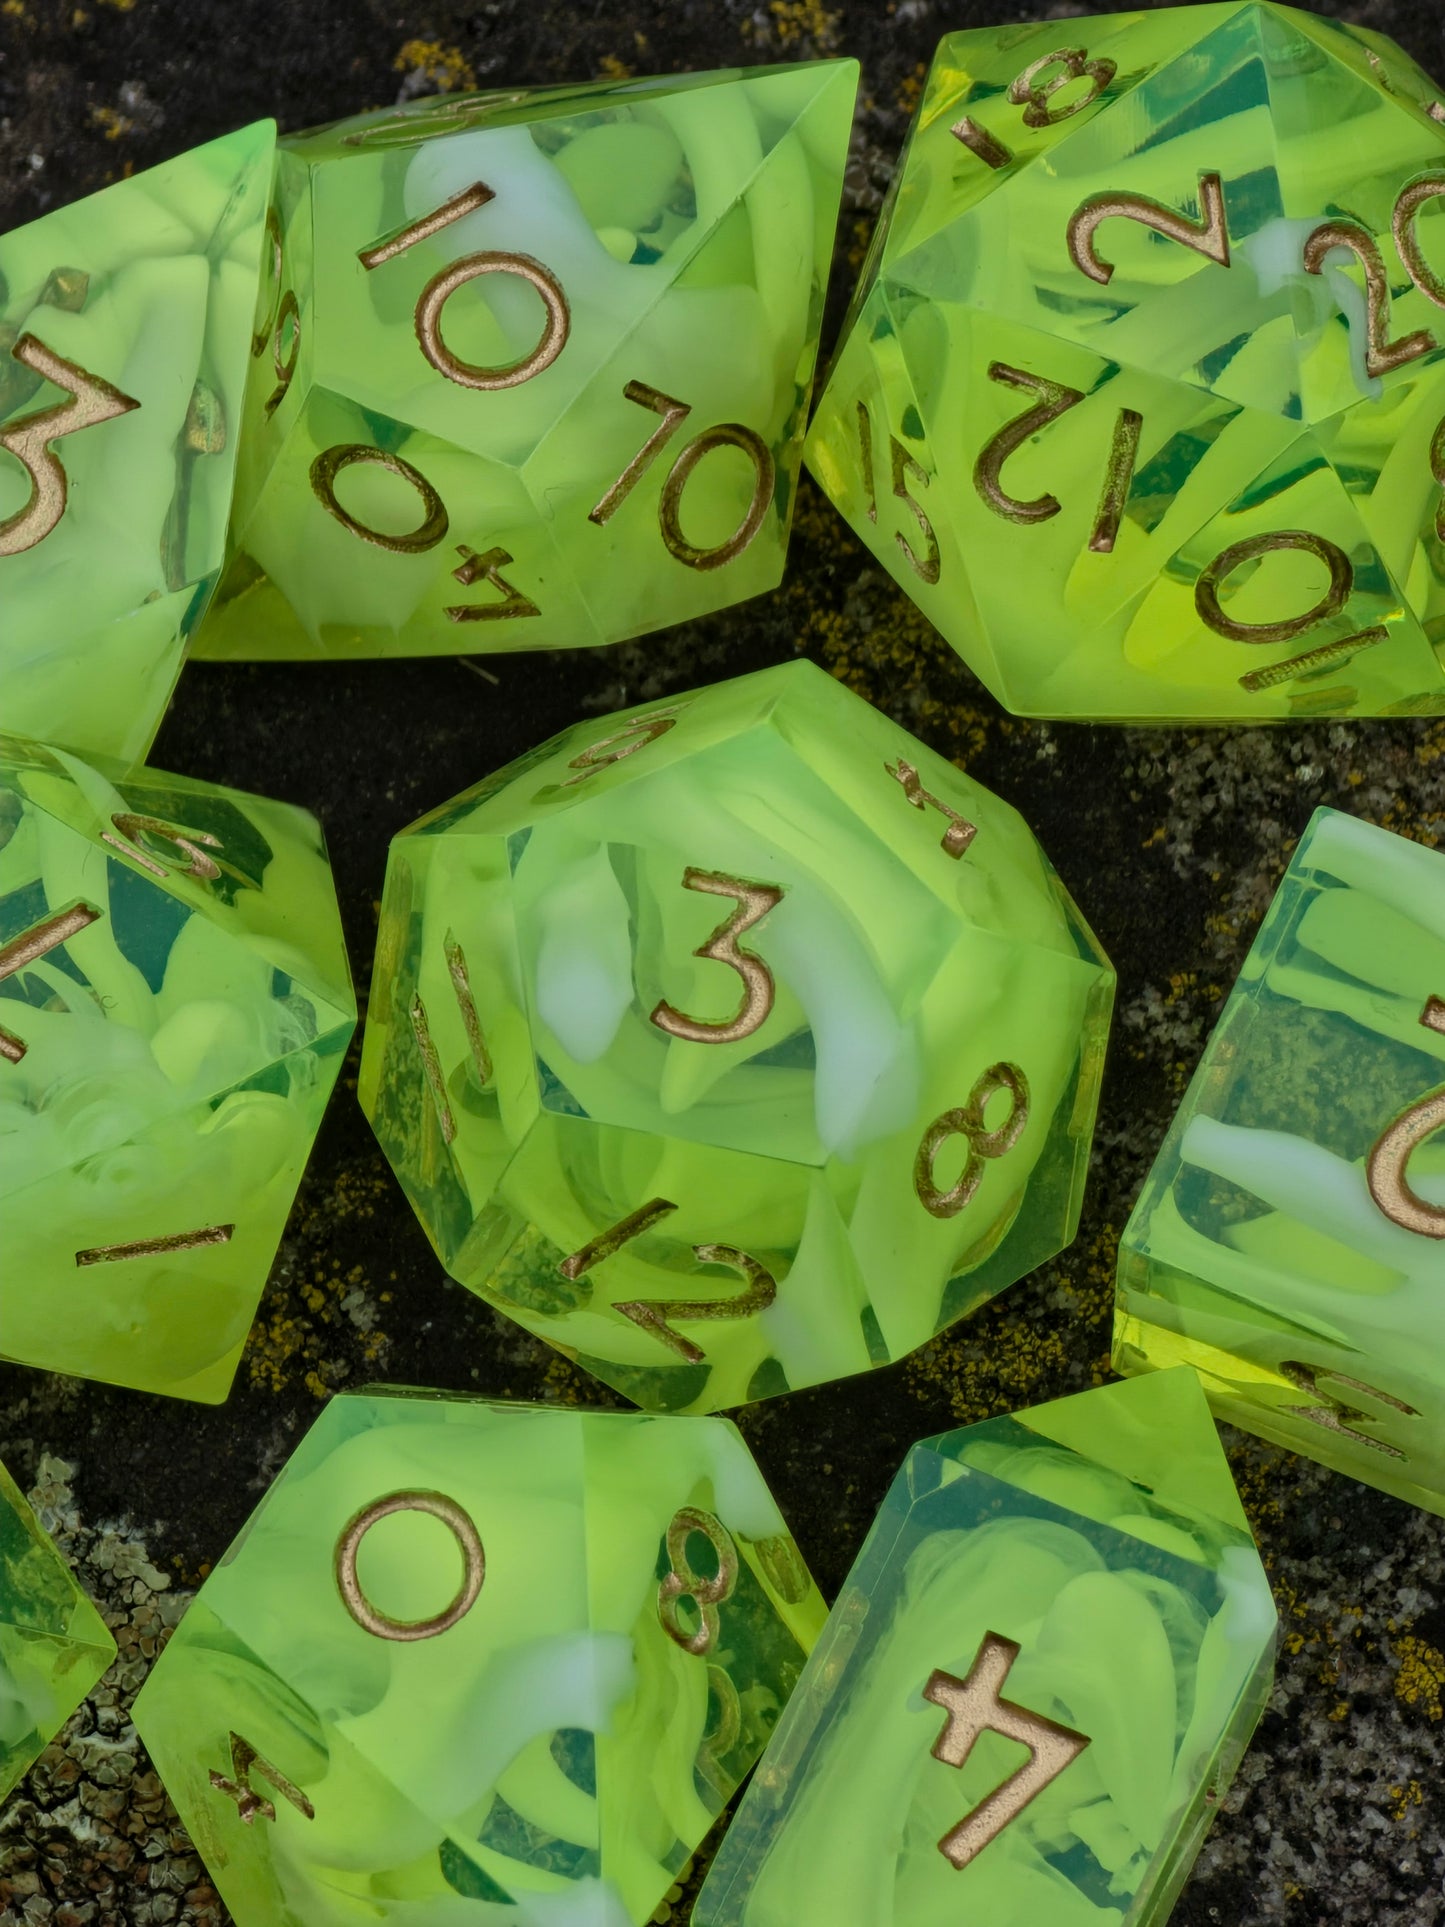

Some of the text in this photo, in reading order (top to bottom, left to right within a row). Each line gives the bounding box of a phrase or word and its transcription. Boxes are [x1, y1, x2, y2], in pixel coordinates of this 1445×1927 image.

[950, 46, 1118, 169] 18
[357, 180, 571, 391] 10
[1066, 170, 1230, 285] 2
[309, 443, 541, 622] 40
[588, 379, 776, 570] 70
[857, 399, 941, 586] 15
[973, 360, 1143, 553] 12
[1195, 529, 1391, 692] 10
[650, 866, 785, 1045] 3
[913, 1061, 1029, 1218] 8
[560, 1197, 778, 1366] 12
[333, 1487, 486, 1642] 0
[658, 1506, 739, 1657] 8
[923, 1629, 1092, 1871] 4
